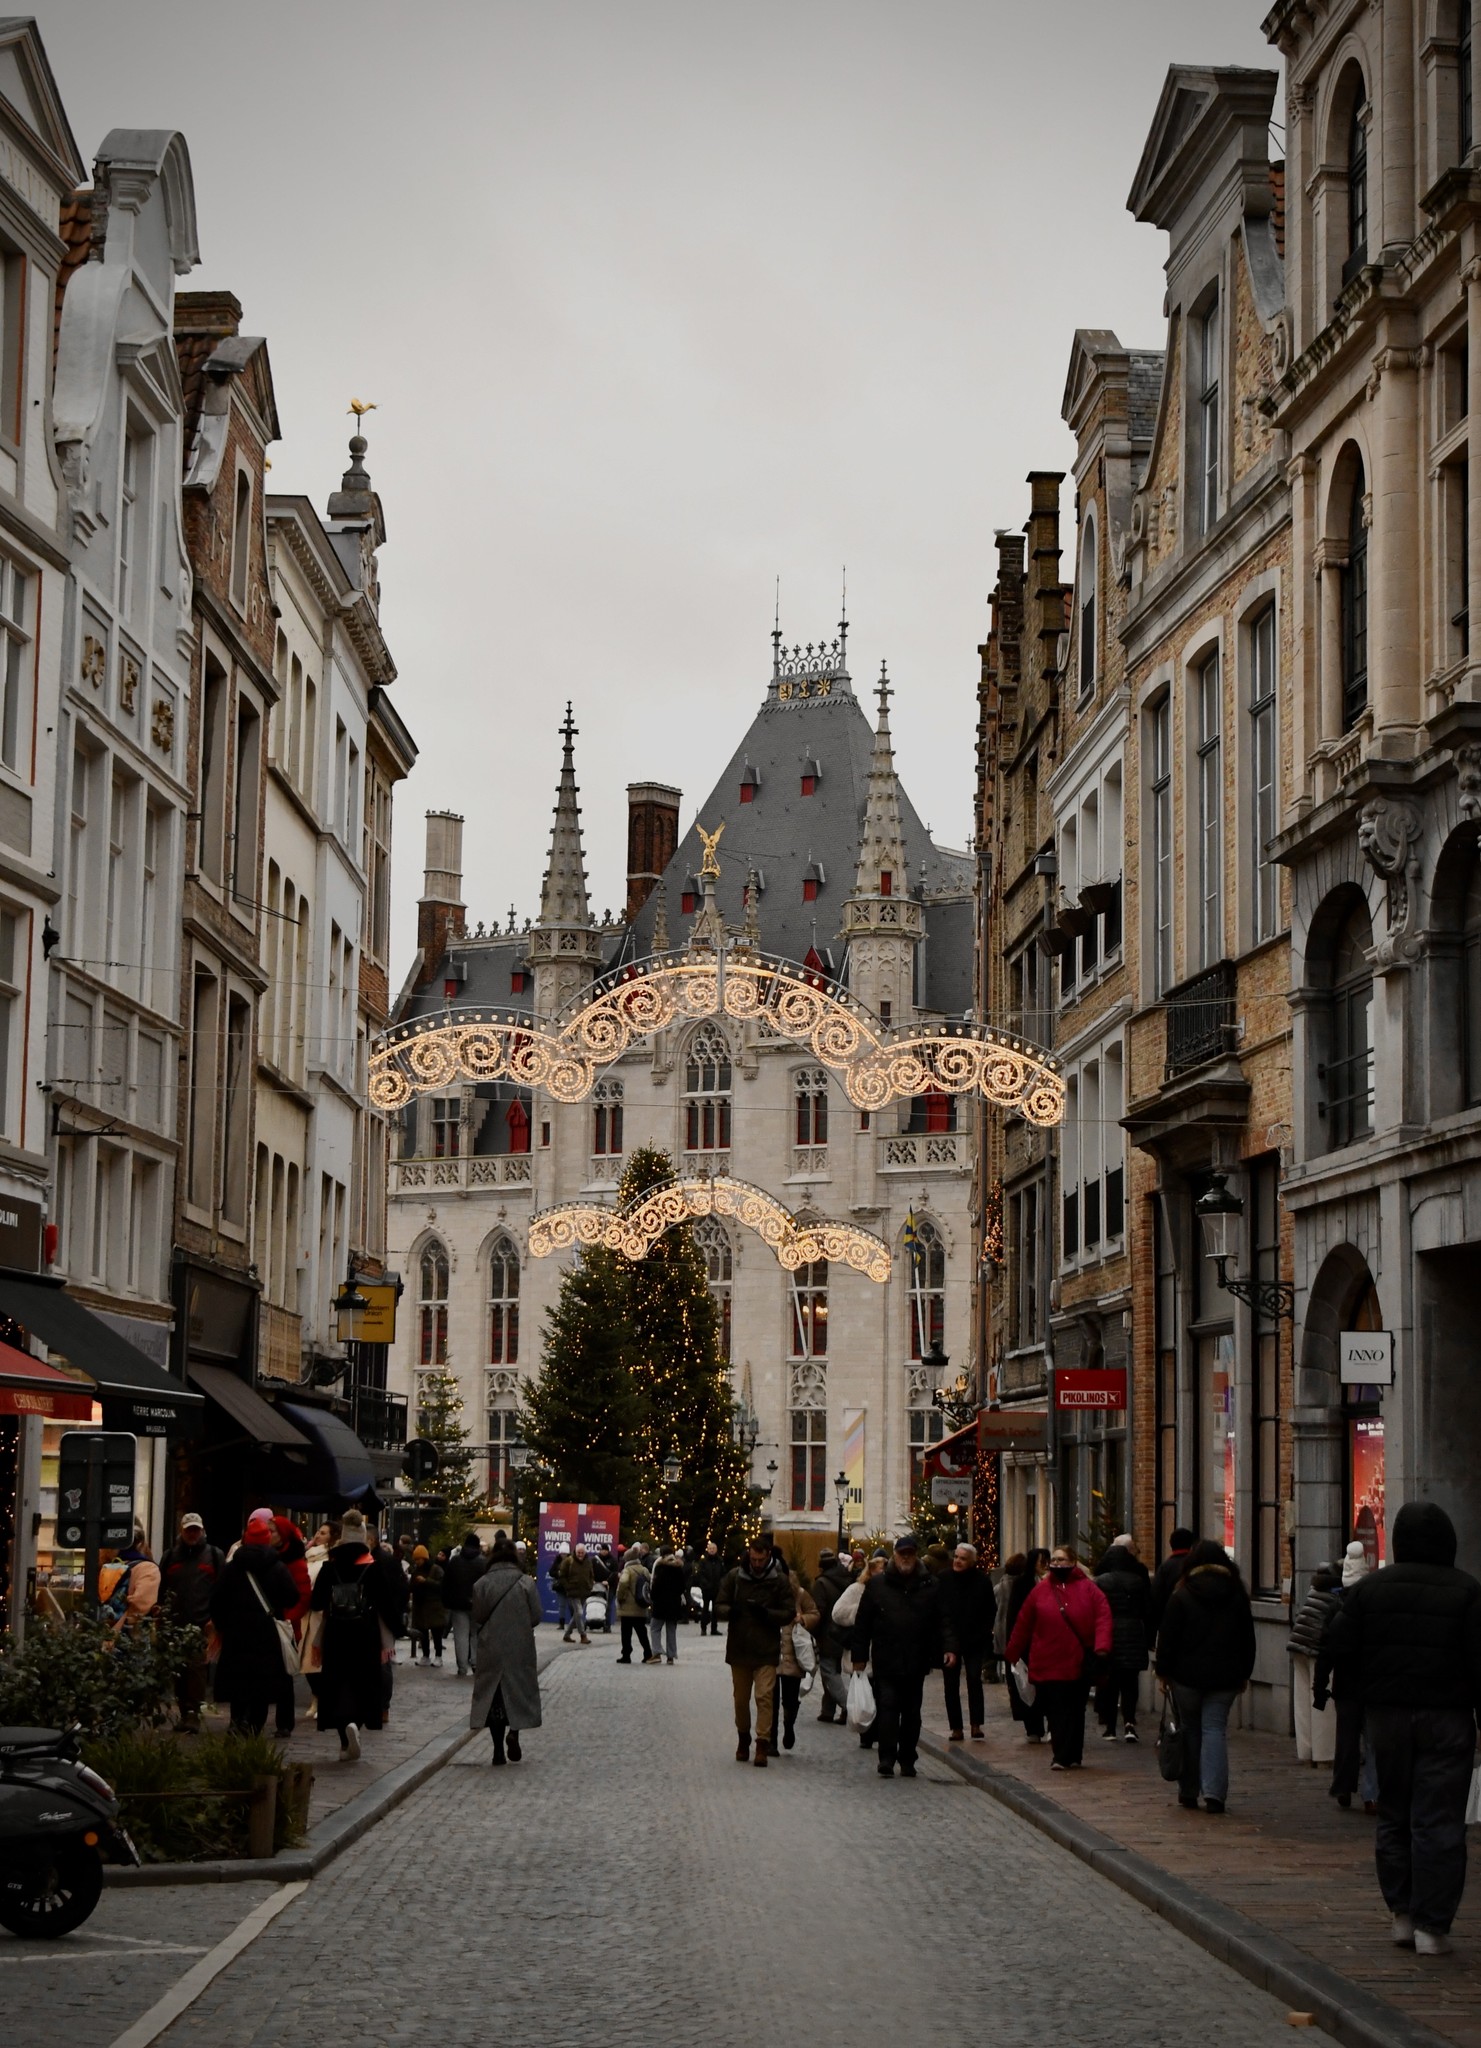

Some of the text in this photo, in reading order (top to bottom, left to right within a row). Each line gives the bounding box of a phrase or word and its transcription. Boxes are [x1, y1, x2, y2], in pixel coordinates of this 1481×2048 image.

[1348, 1349, 1384, 1361] INNO
[1062, 1392, 1106, 1403] PIKOLINOS
[544, 1531, 571, 1542] WINTER
[583, 1533, 613, 1543] WINTER
[0, 1744, 17, 1753] GTS
